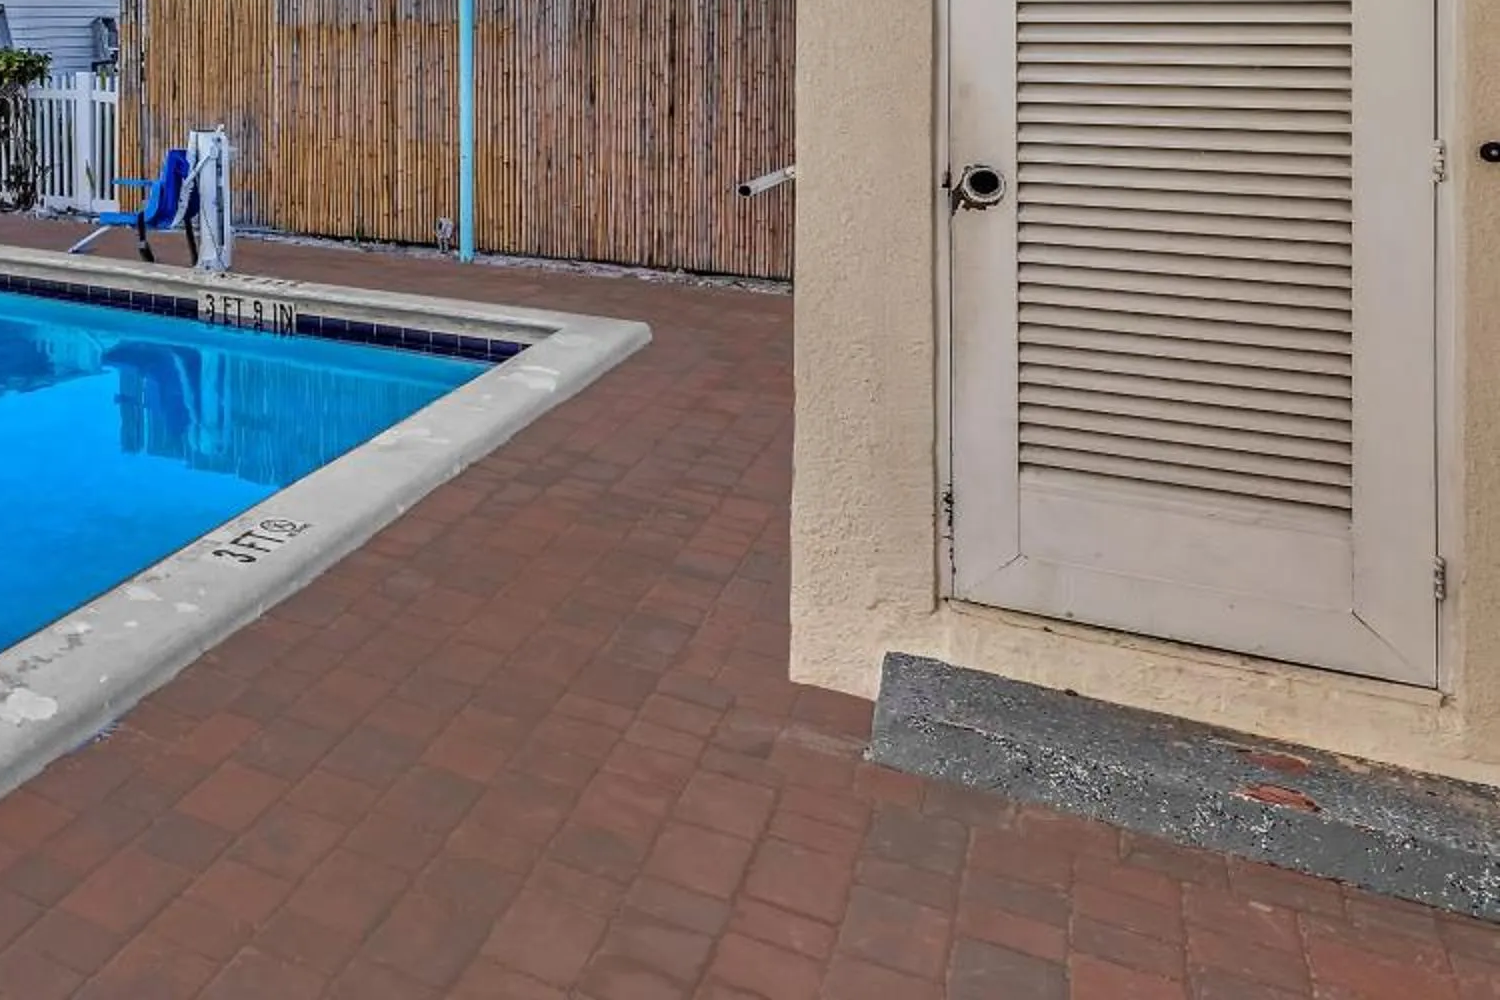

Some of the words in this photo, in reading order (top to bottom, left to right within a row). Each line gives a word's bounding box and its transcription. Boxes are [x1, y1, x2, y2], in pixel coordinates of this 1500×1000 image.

[273, 303, 294, 331] IN
[229, 529, 285, 552] FT
[212, 549, 257, 563] 3
